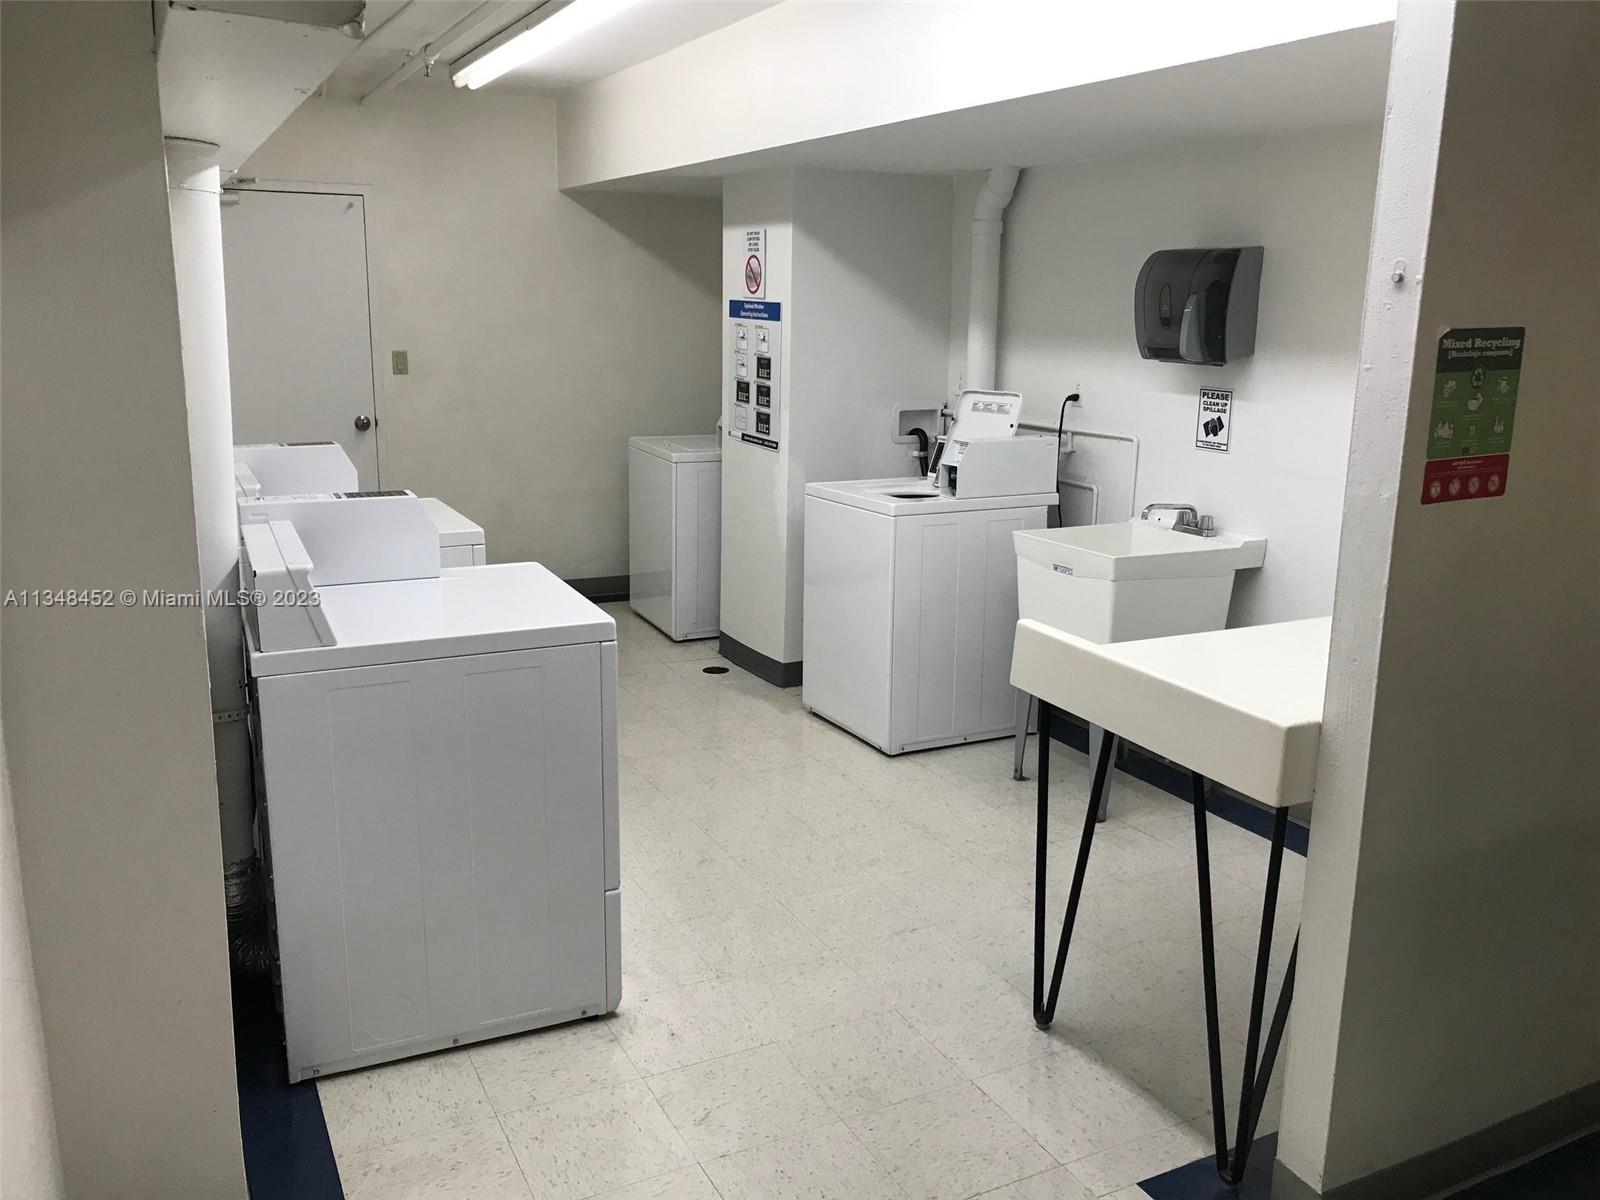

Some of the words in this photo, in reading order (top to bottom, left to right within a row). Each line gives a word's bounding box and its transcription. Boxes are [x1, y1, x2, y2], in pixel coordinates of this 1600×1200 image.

[1442, 338, 1473, 349] Mixed
[1474, 337, 1521, 349] Recycling
[1202, 391, 1230, 401] PLEASE
[1203, 406, 1227, 414] SPILLAGE
